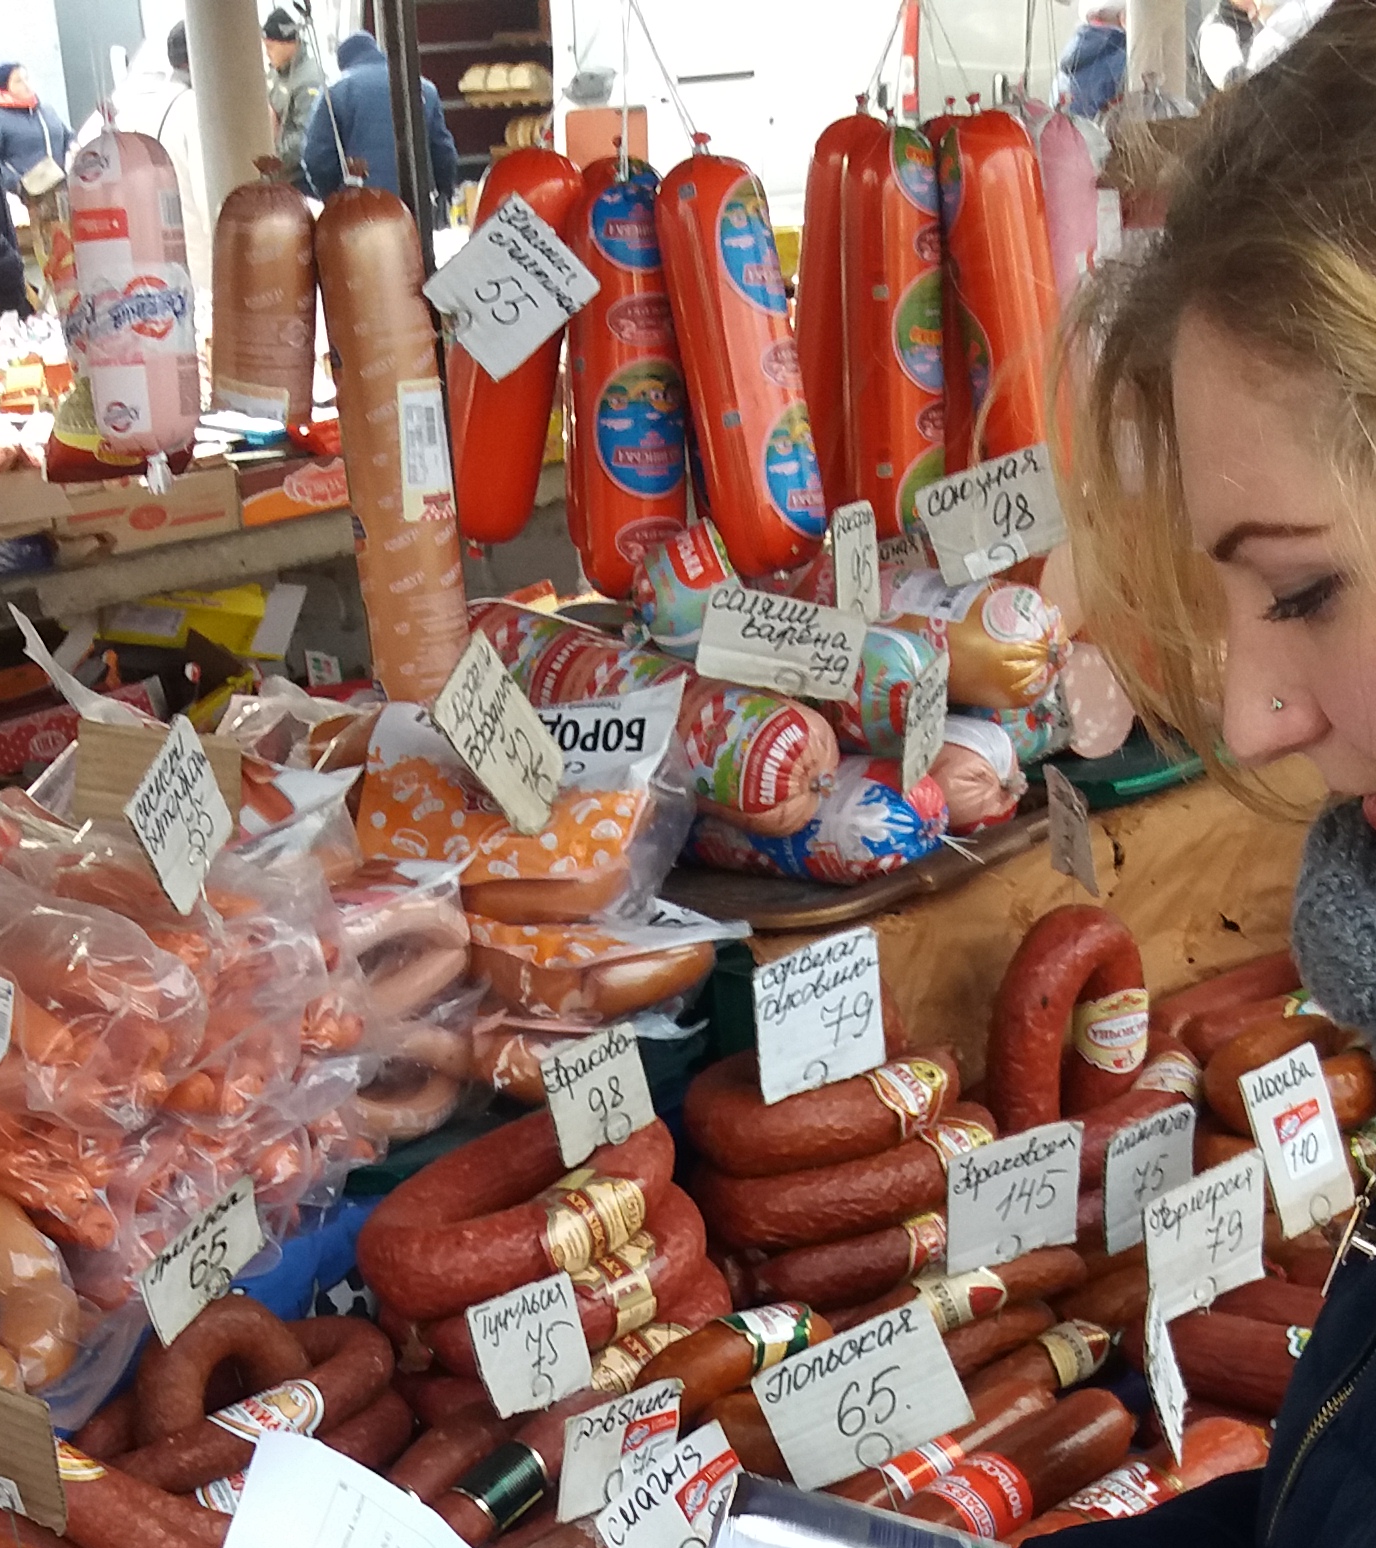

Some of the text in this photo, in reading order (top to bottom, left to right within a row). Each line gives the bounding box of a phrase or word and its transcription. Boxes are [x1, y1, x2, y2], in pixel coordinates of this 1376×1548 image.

[474, 274, 540, 326] 55
[992, 490, 1037, 539] 98
[820, 989, 874, 1048] 79
[588, 1075, 625, 1123] 98
[995, 1168, 1070, 1223] 145
[188, 1226, 228, 1290] 65
[1205, 1210, 1245, 1263] 79
[525, 1320, 576, 1375] 75
